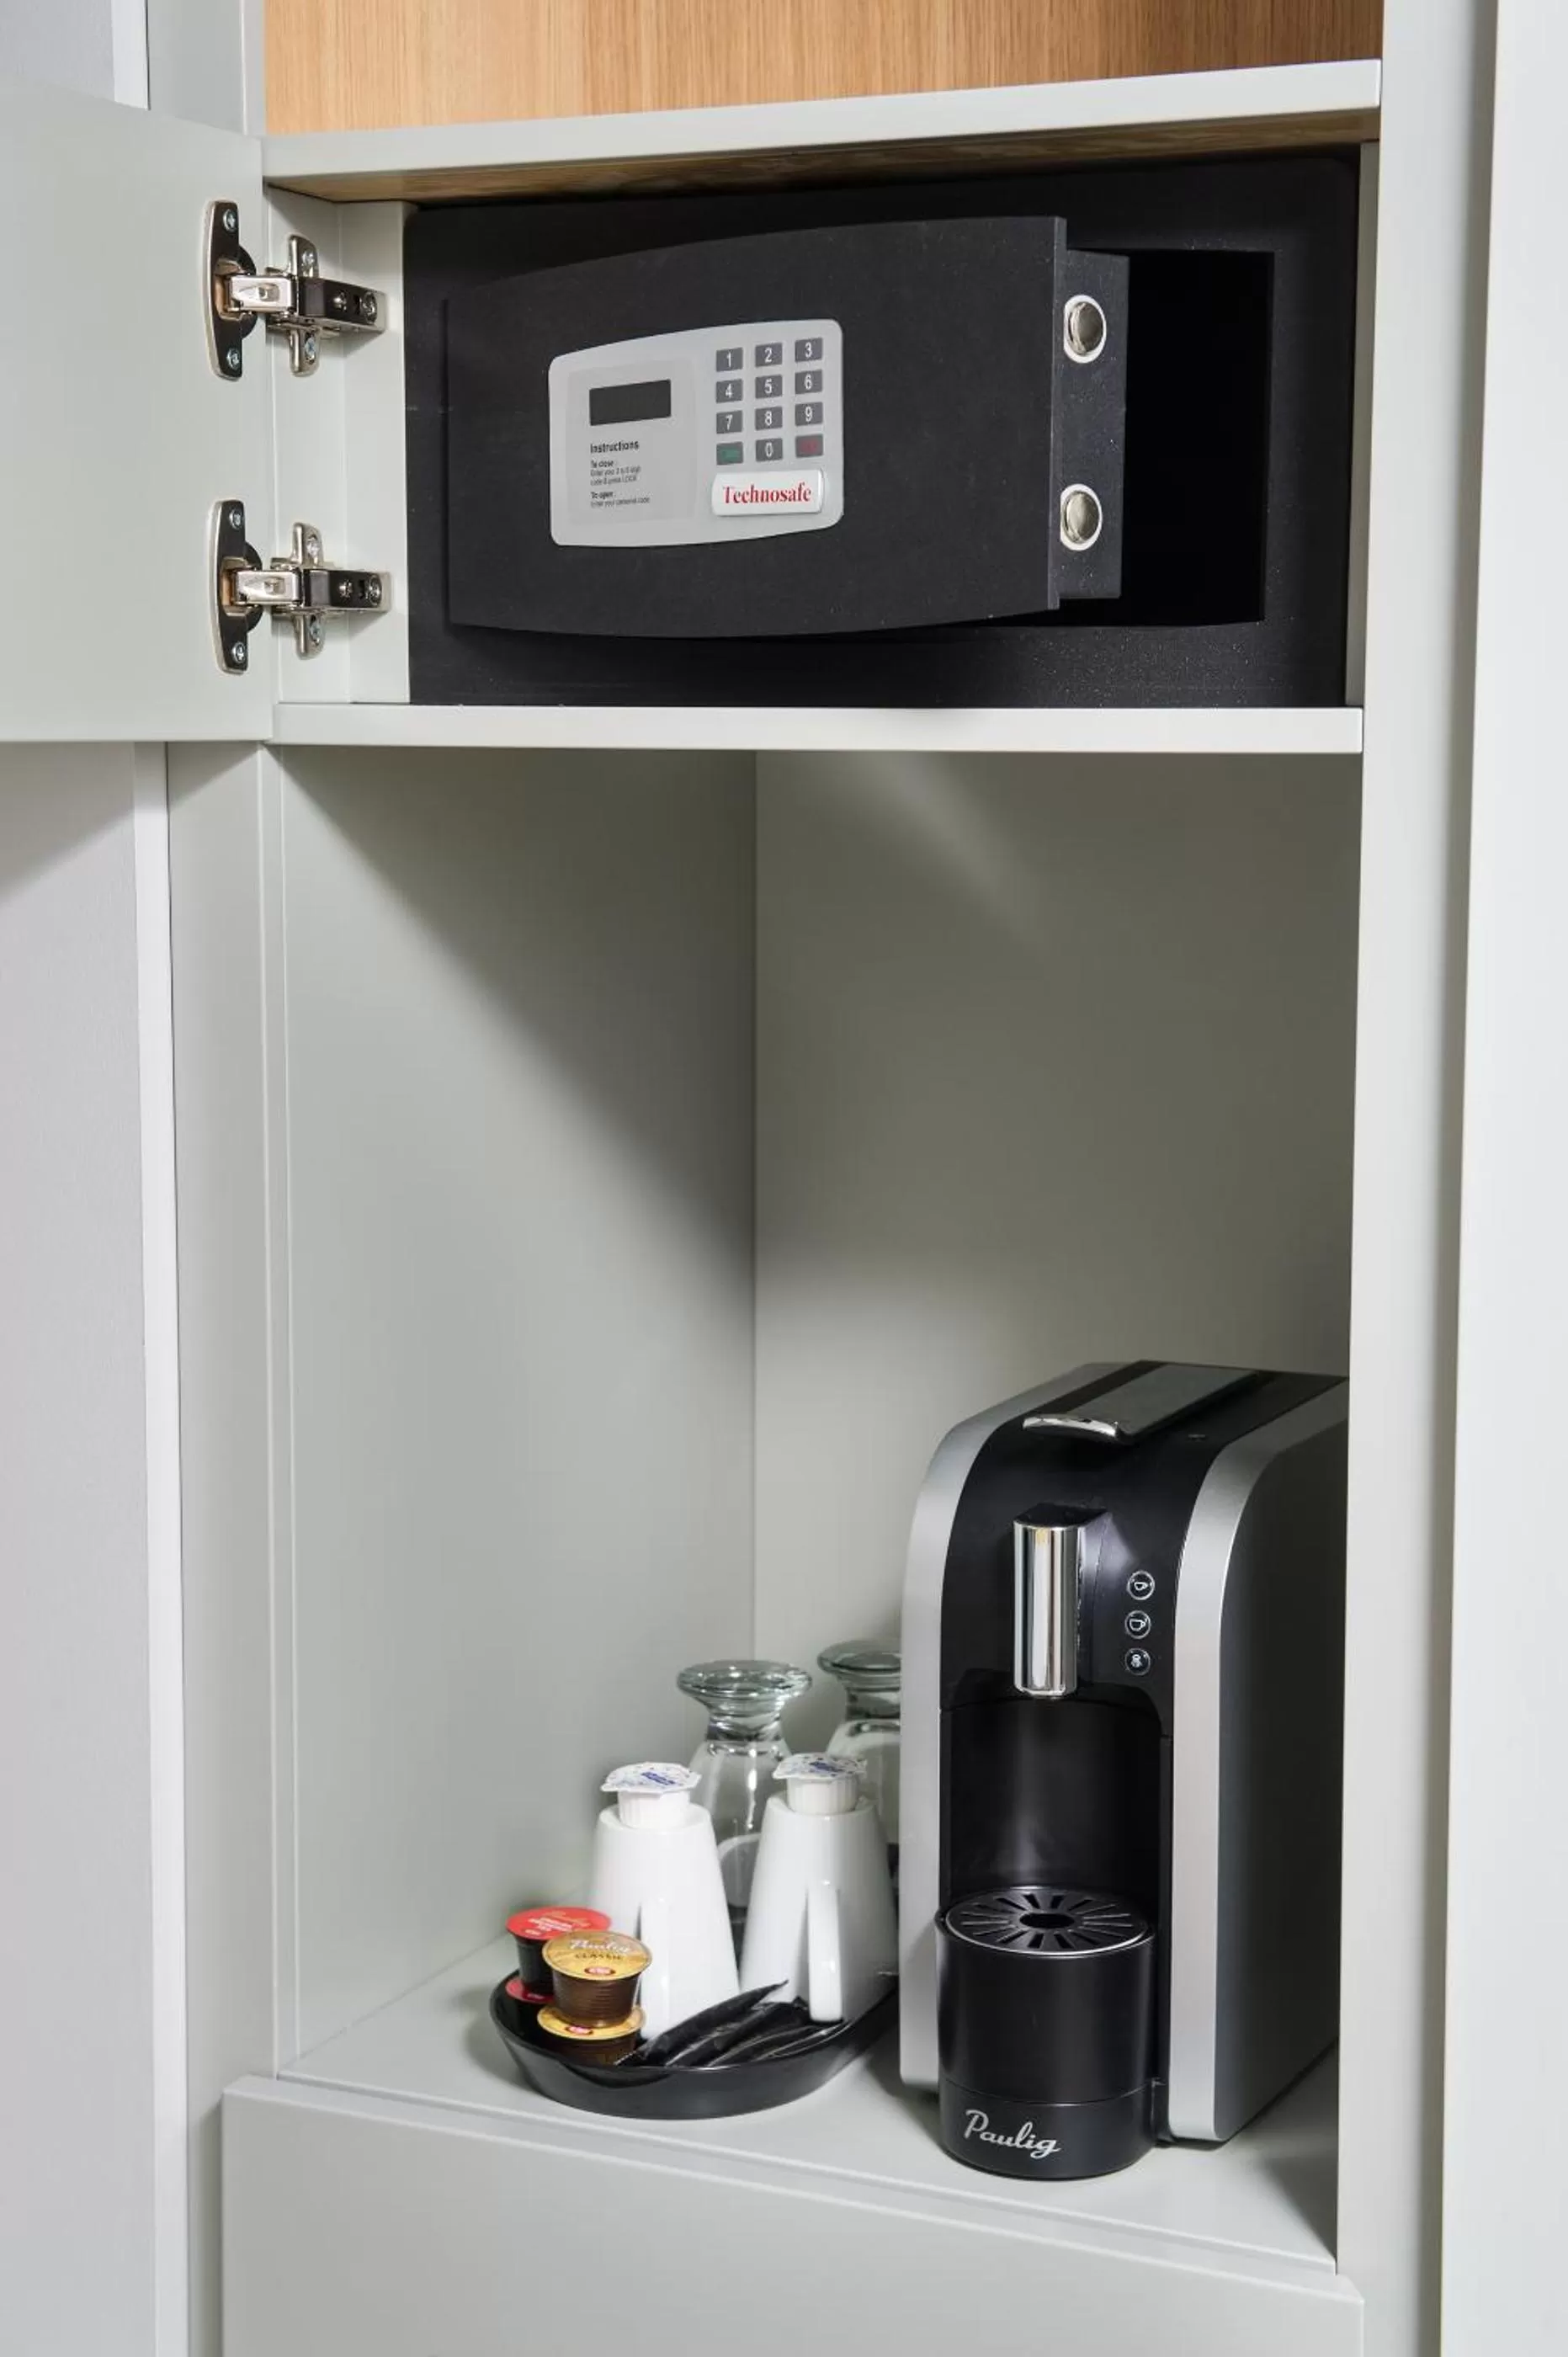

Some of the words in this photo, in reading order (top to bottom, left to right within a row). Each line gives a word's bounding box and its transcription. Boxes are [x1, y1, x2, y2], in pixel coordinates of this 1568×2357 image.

[726, 351, 732, 368] 1
[764, 347, 773, 363] 2
[805, 342, 812, 358] 3
[726, 383, 733, 398] 4
[764, 378, 773, 394] 5
[804, 374, 813, 390] 6
[726, 414, 733, 430] 7
[764, 410, 773, 426] 8
[805, 406, 813, 422] 9
[590, 441, 640, 454] Instructions
[764, 442, 773, 457] 0
[722, 482, 812, 503] Technosafe
[963, 2109, 1062, 2160] Paulig
